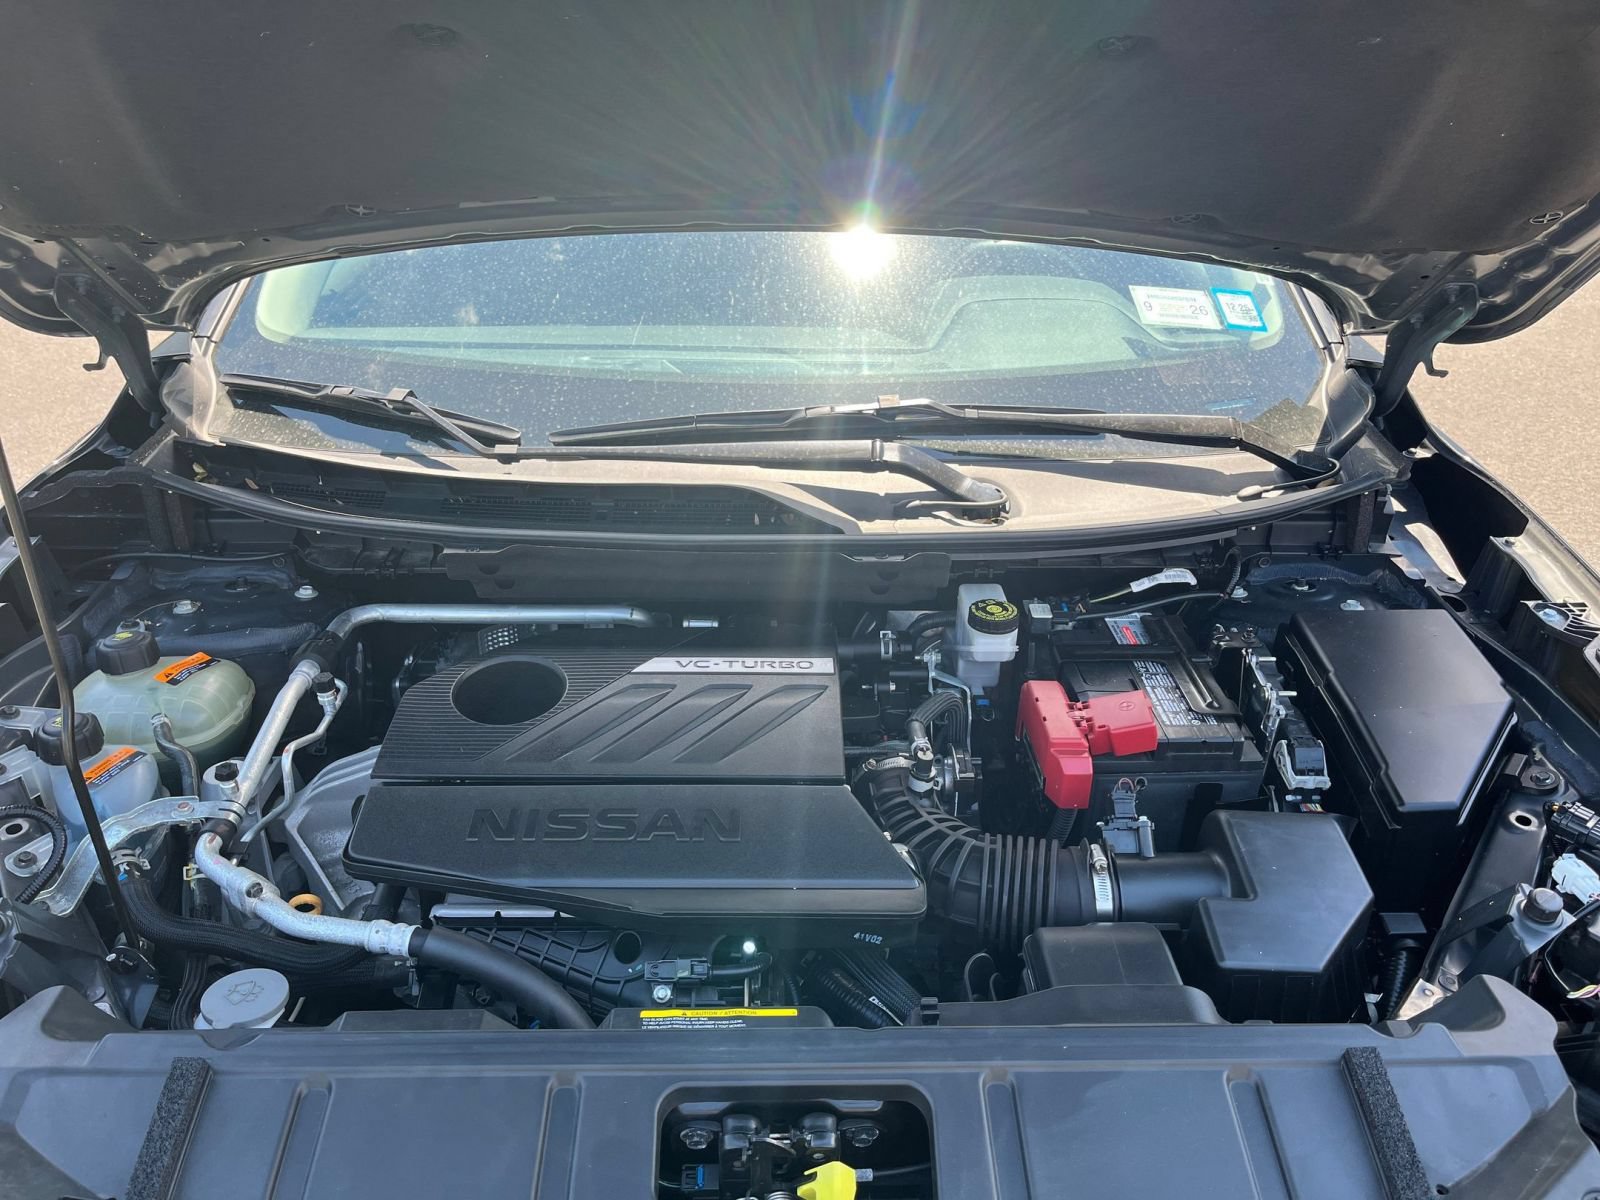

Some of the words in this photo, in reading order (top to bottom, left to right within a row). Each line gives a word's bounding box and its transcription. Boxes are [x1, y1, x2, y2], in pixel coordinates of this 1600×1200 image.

[1143, 301, 1153, 312] 9
[1189, 305, 1209, 316] 26
[675, 660, 814, 670] VC-TURBO
[465, 808, 742, 842] NISSAN
